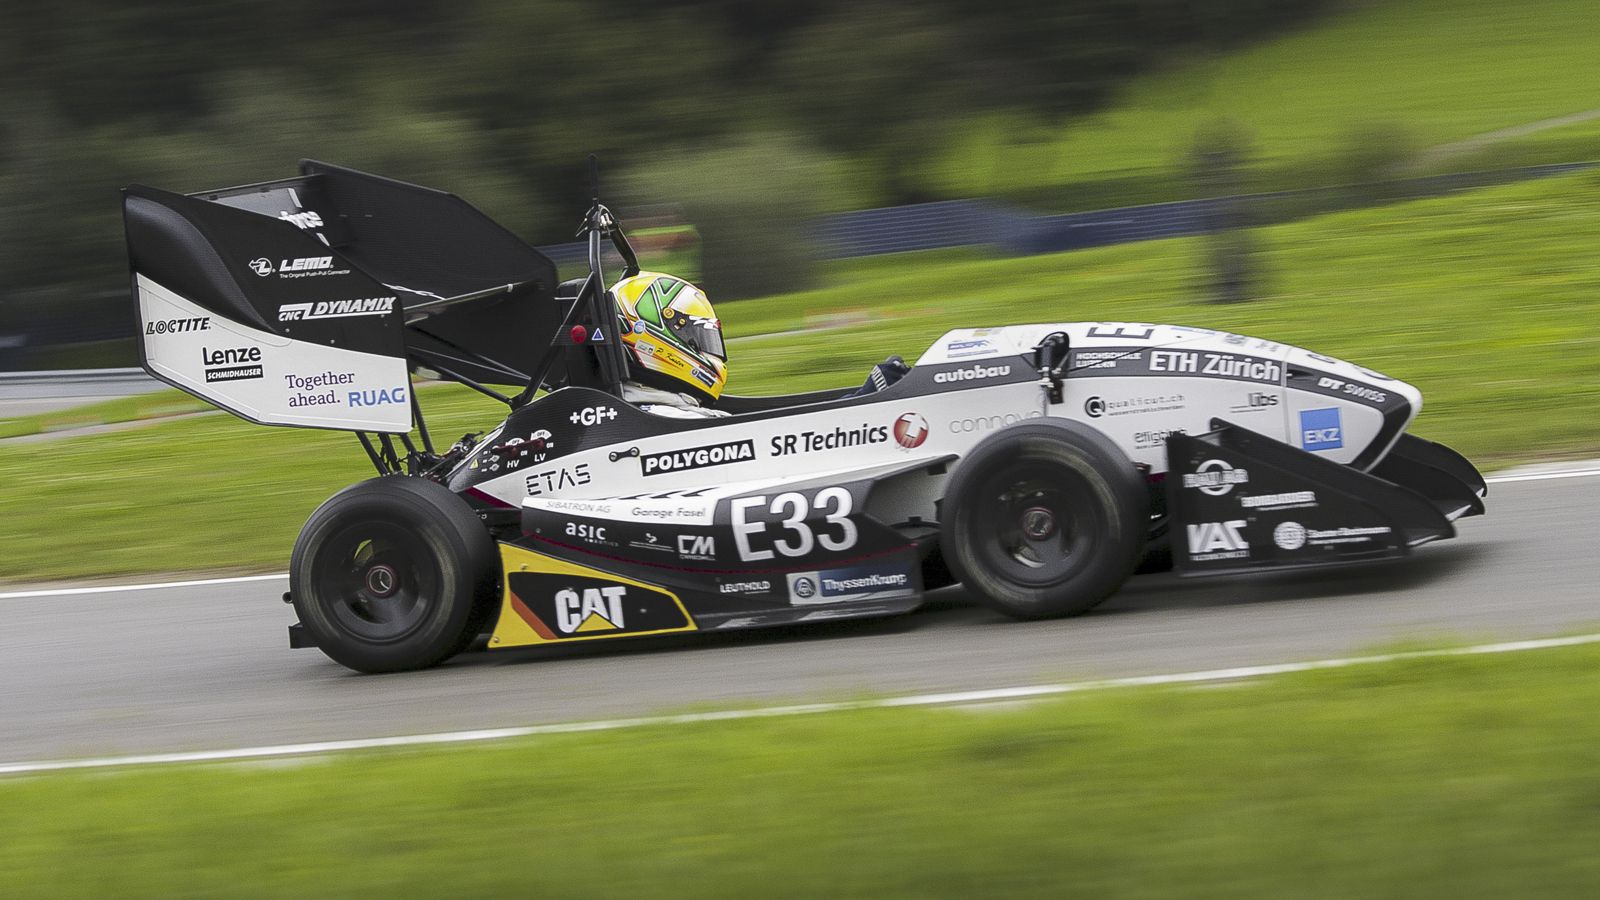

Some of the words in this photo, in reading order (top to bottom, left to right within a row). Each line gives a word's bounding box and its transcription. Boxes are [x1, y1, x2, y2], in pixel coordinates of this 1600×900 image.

[279, 256, 333, 272] LEMO
[279, 311, 302, 321] CNC
[315, 297, 396, 316] DYNAMIX
[145, 318, 210, 335] LOCTITE
[203, 346, 262, 366] Lenze
[206, 368, 262, 380] SCHMIDHAUSER
[933, 364, 1011, 384] autobau
[1150, 350, 1198, 373] ETH
[1203, 353, 1281, 382] Zürich
[285, 372, 355, 391] Together
[1317, 376, 1345, 390] DT
[1343, 383, 1387, 403] SWISS
[288, 390, 340, 407] ahead.
[348, 387, 405, 408] RUAG
[771, 434, 798, 457] SR
[801, 423, 888, 452] Technics
[1304, 427, 1340, 444] EKZ
[506, 459, 520, 469] HV
[534, 453, 546, 462] LV
[645, 443, 752, 473] POLYGONA
[526, 463, 591, 496] ETAS
[546, 500, 593, 513] SIBATRON
[595, 504, 611, 514] AG
[632, 507, 674, 519] Garage
[676, 506, 706, 517] Fasel
[565, 522, 606, 541] asic
[731, 486, 858, 563] E33
[677, 534, 716, 555] CM
[720, 581, 771, 593] LEUTHOLD
[822, 574, 907, 592] ThyssenKrupp
[555, 586, 627, 634] CAT
